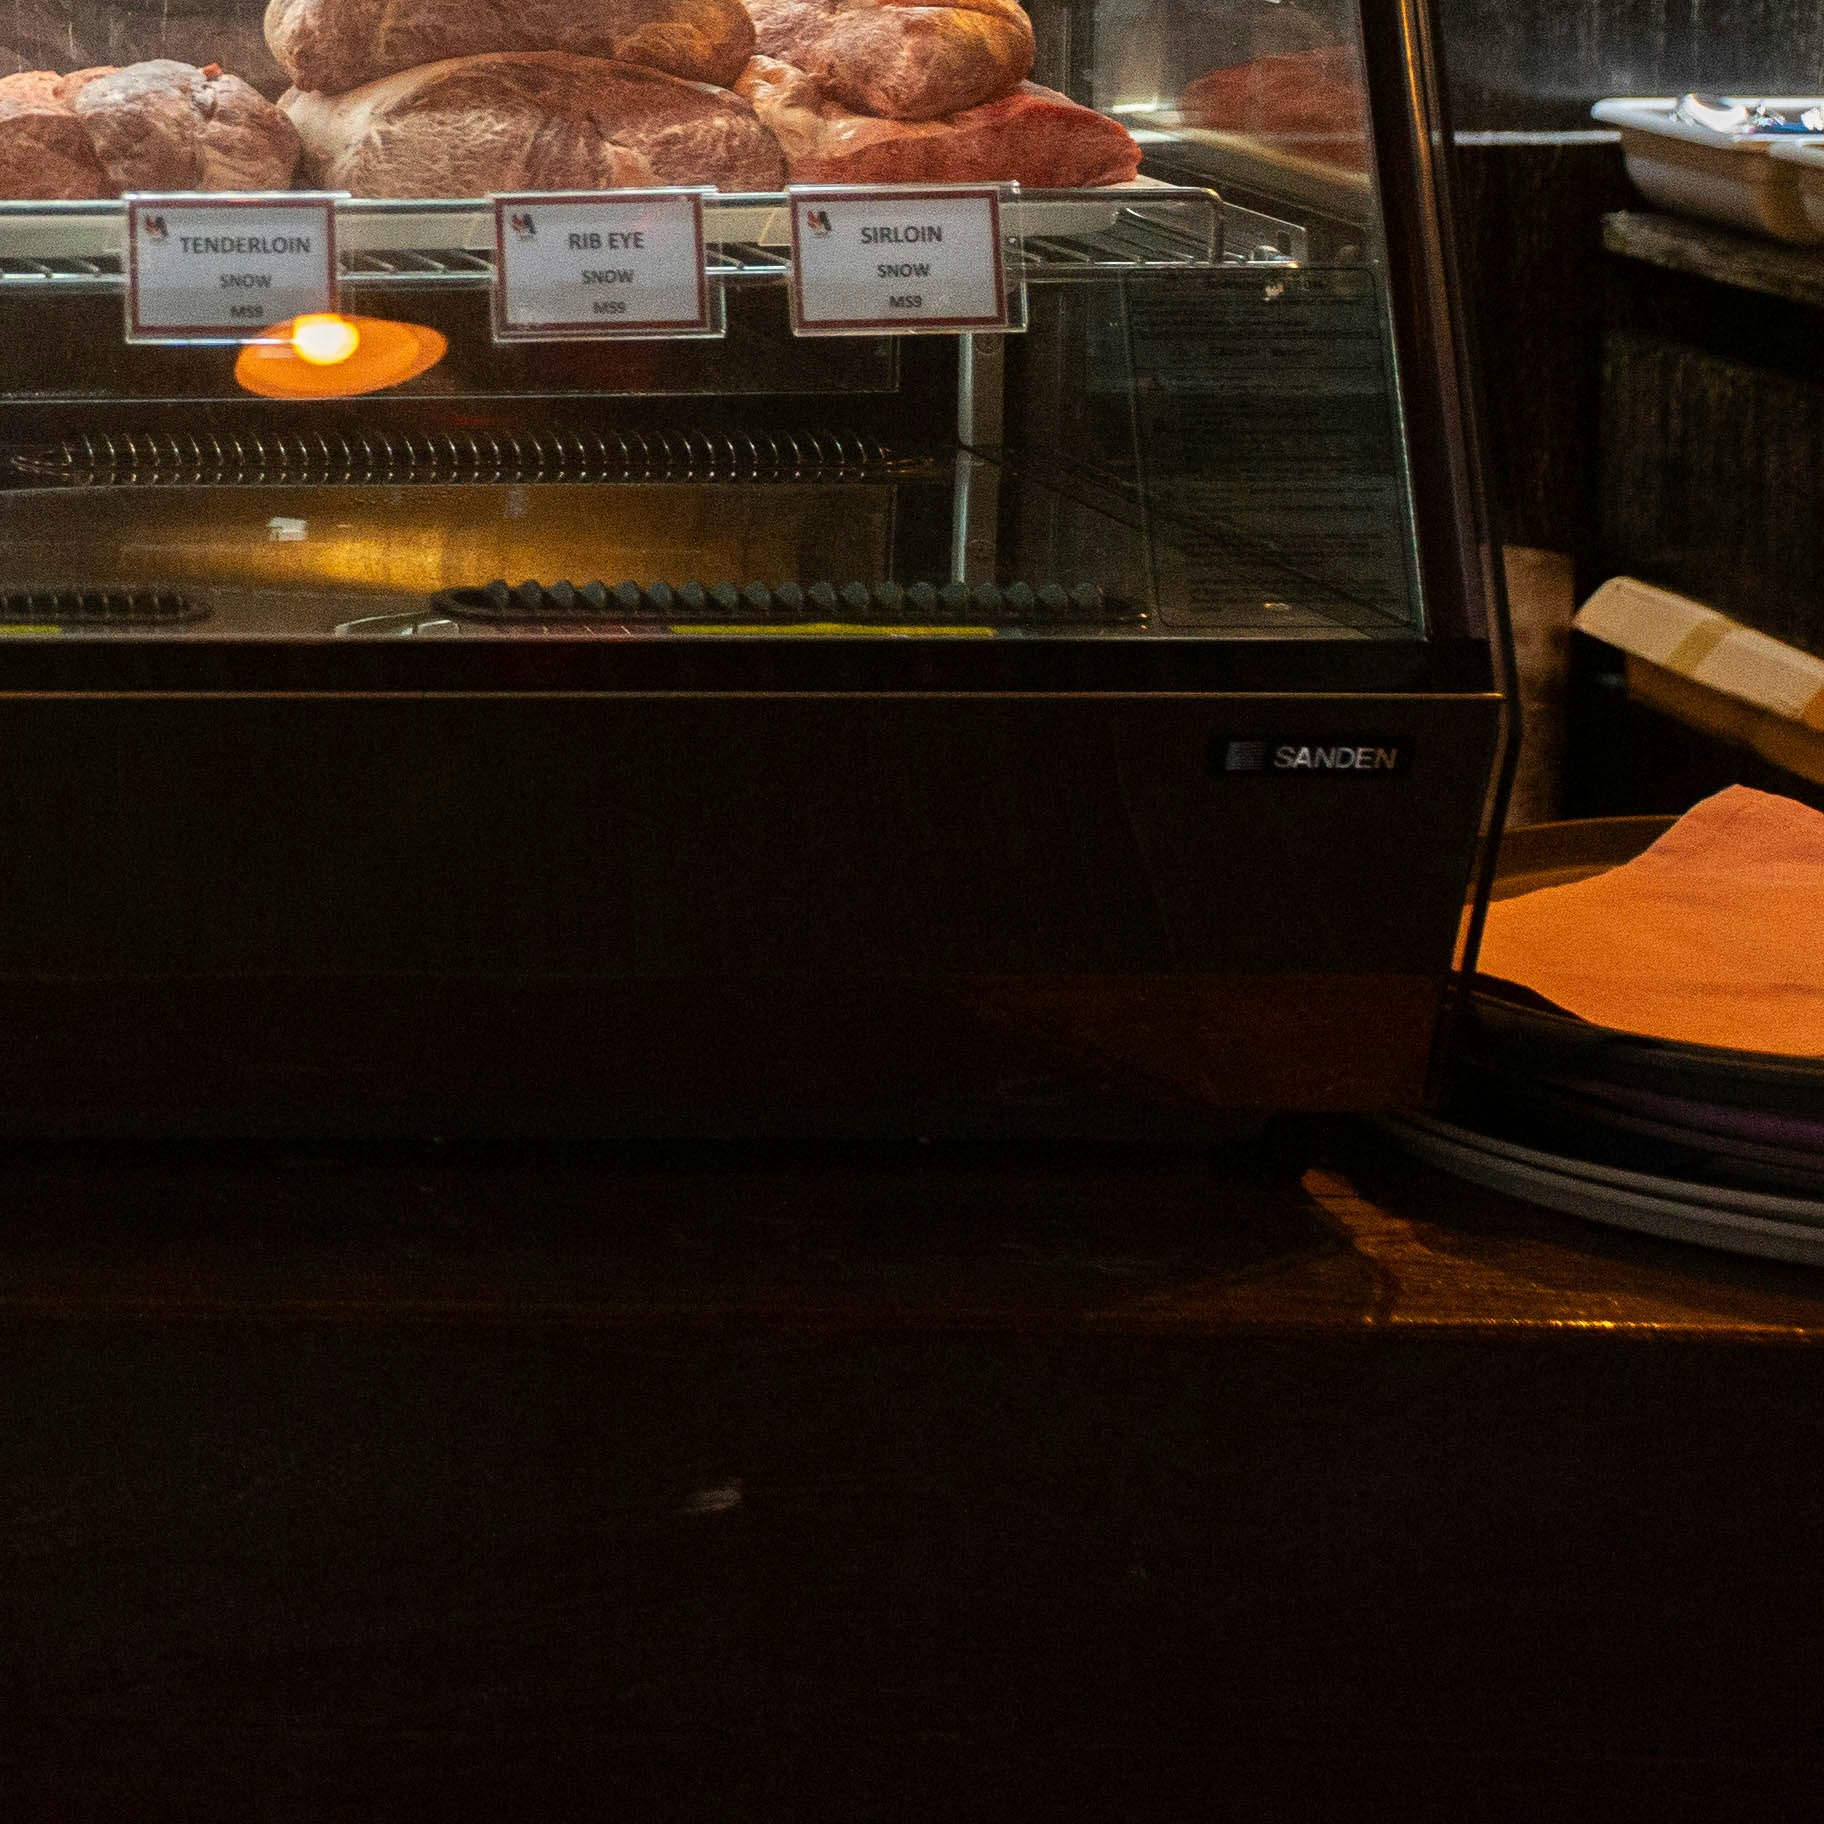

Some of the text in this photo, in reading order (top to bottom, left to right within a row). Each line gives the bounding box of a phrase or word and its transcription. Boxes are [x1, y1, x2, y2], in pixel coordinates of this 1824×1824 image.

[568, 231, 645, 250] RIB EYE
[860, 225, 943, 244] SIRLOIN
[180, 236, 311, 255] TENDERLOIN
[581, 269, 635, 285] SNOW
[876, 263, 931, 278] SNOW
[219, 273, 273, 289] SNOW
[888, 295, 923, 308] MS9
[1273, 745, 1399, 770] SANDEN
